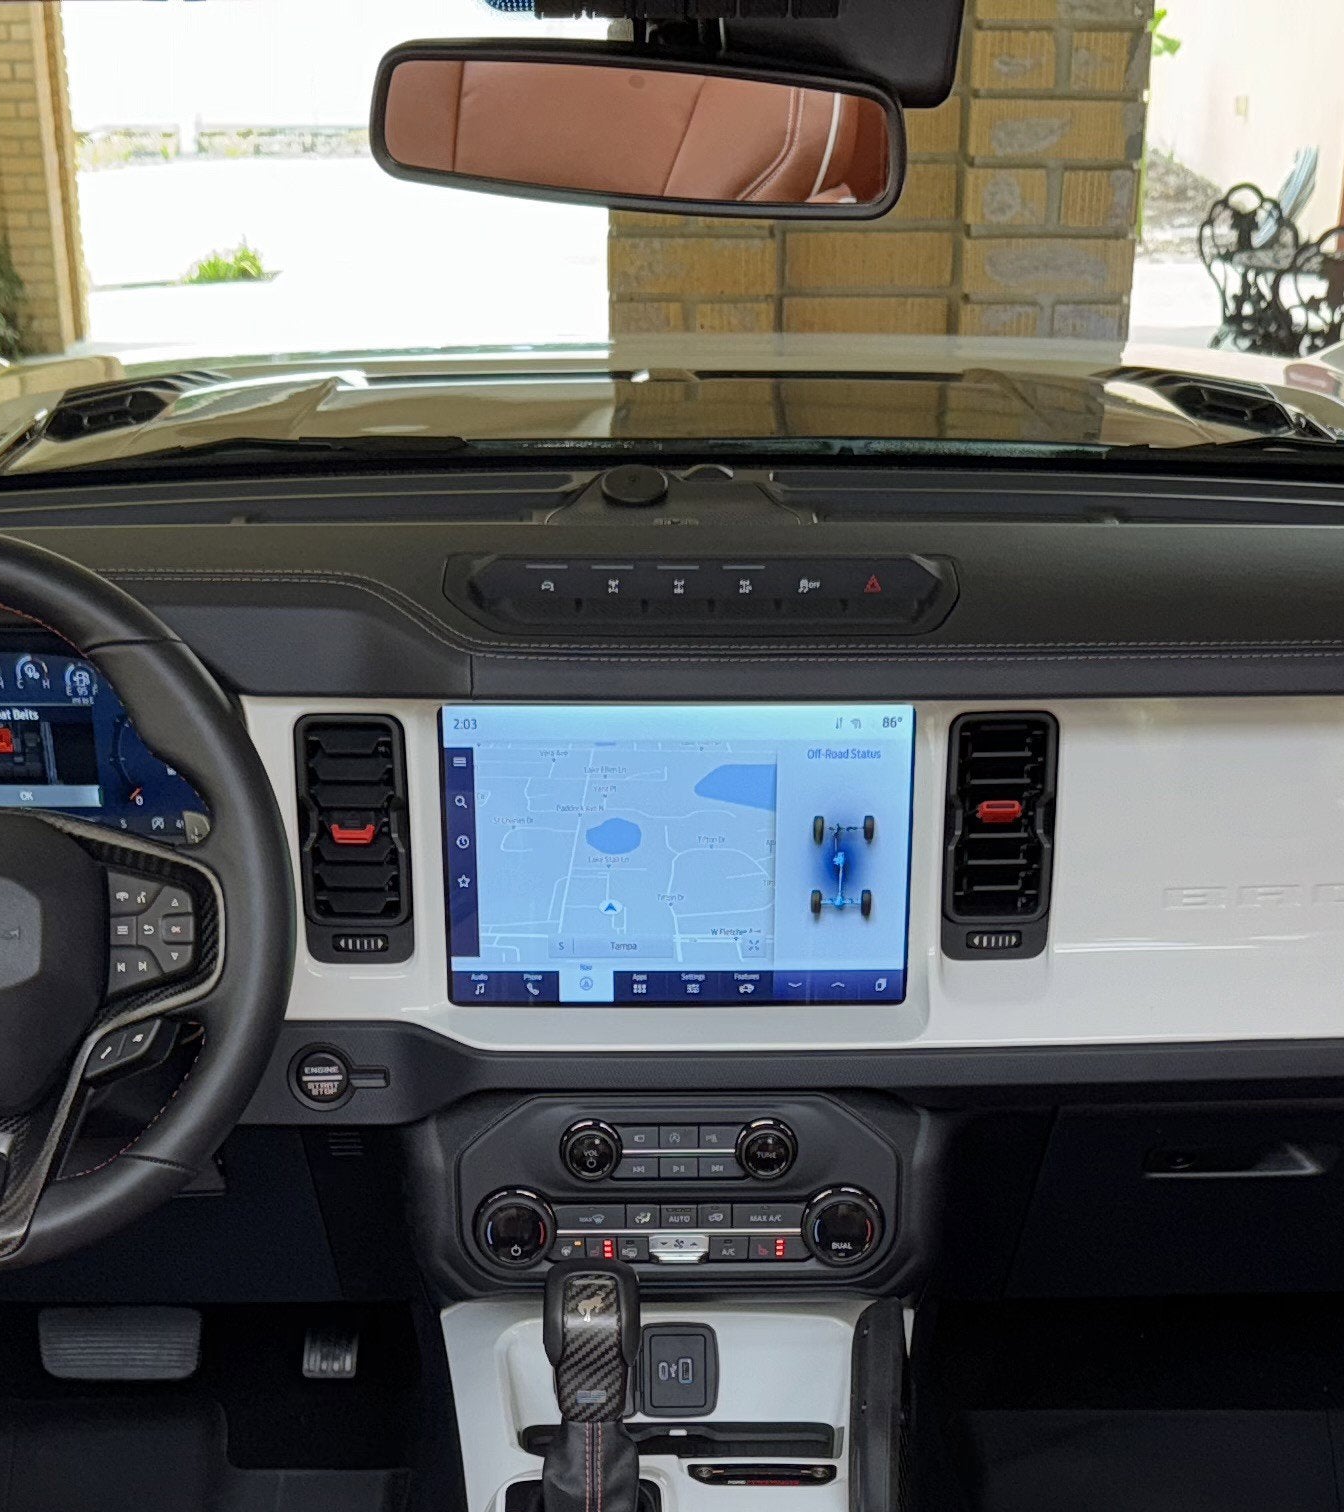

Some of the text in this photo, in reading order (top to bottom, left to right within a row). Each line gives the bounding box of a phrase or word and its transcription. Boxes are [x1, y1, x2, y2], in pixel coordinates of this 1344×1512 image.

[13, 708, 40, 721] Belts
[453, 718, 478, 730] 2:03
[882, 716, 903, 729] 86°
[807, 748, 882, 760] Off-Road Status
[20, 791, 34, 801] OK
[558, 941, 565, 951] S
[610, 941, 638, 952] Tampa
[583, 1149, 599, 1158] VOL
[668, 1215, 691, 1223] AUTO
[769, 1214, 782, 1222] A/C
[721, 1247, 736, 1257] A/C
